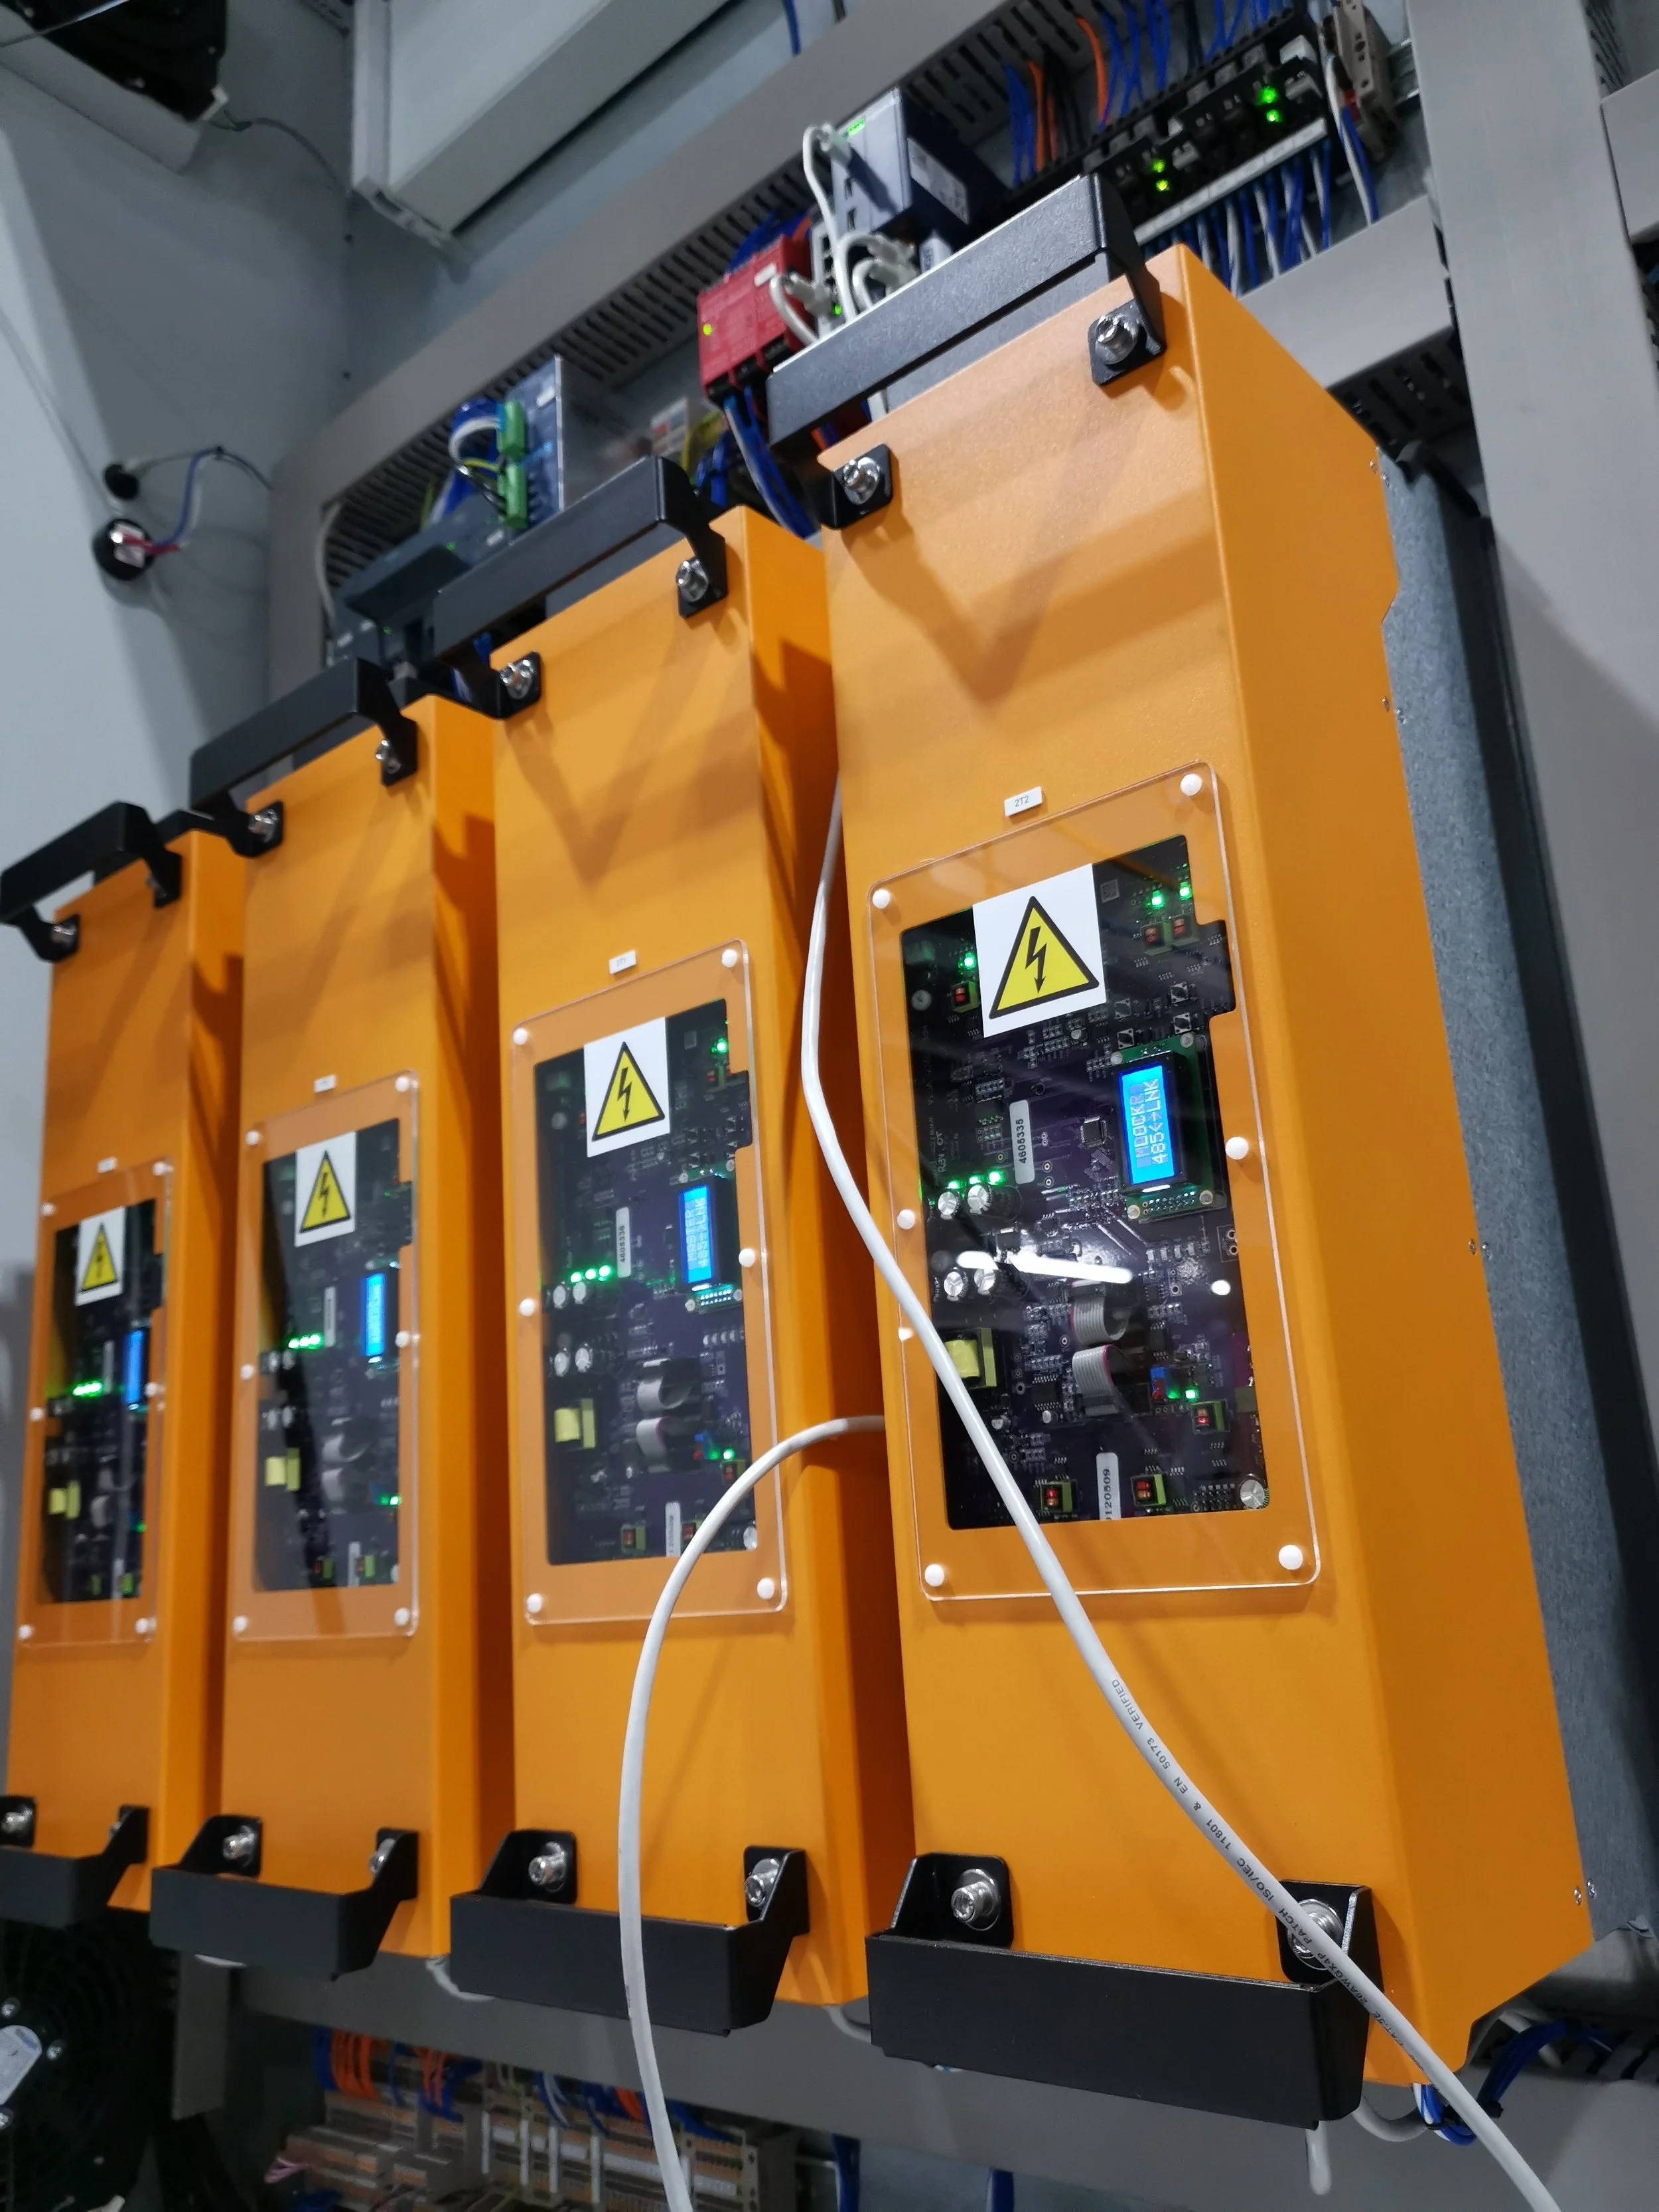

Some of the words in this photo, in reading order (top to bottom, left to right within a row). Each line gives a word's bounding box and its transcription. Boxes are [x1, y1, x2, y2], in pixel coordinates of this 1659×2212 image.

[1014, 795, 1029, 808] 2T2
[1015, 1118, 1027, 1164] 4605335
[1112, 1679, 1143, 1730] VERIFIED
[1147, 1737, 1171, 1769] 50173
[1173, 1777, 1189, 1794] EN
[1193, 1801, 1202, 1810] &
[1206, 1818, 1232, 1850] 11801
[1236, 1857, 1274, 1901] ISO/IEC
[1278, 1908, 1313, 1945] PATCH
[1318, 1952, 1368, 2005] 26AWGX4P
